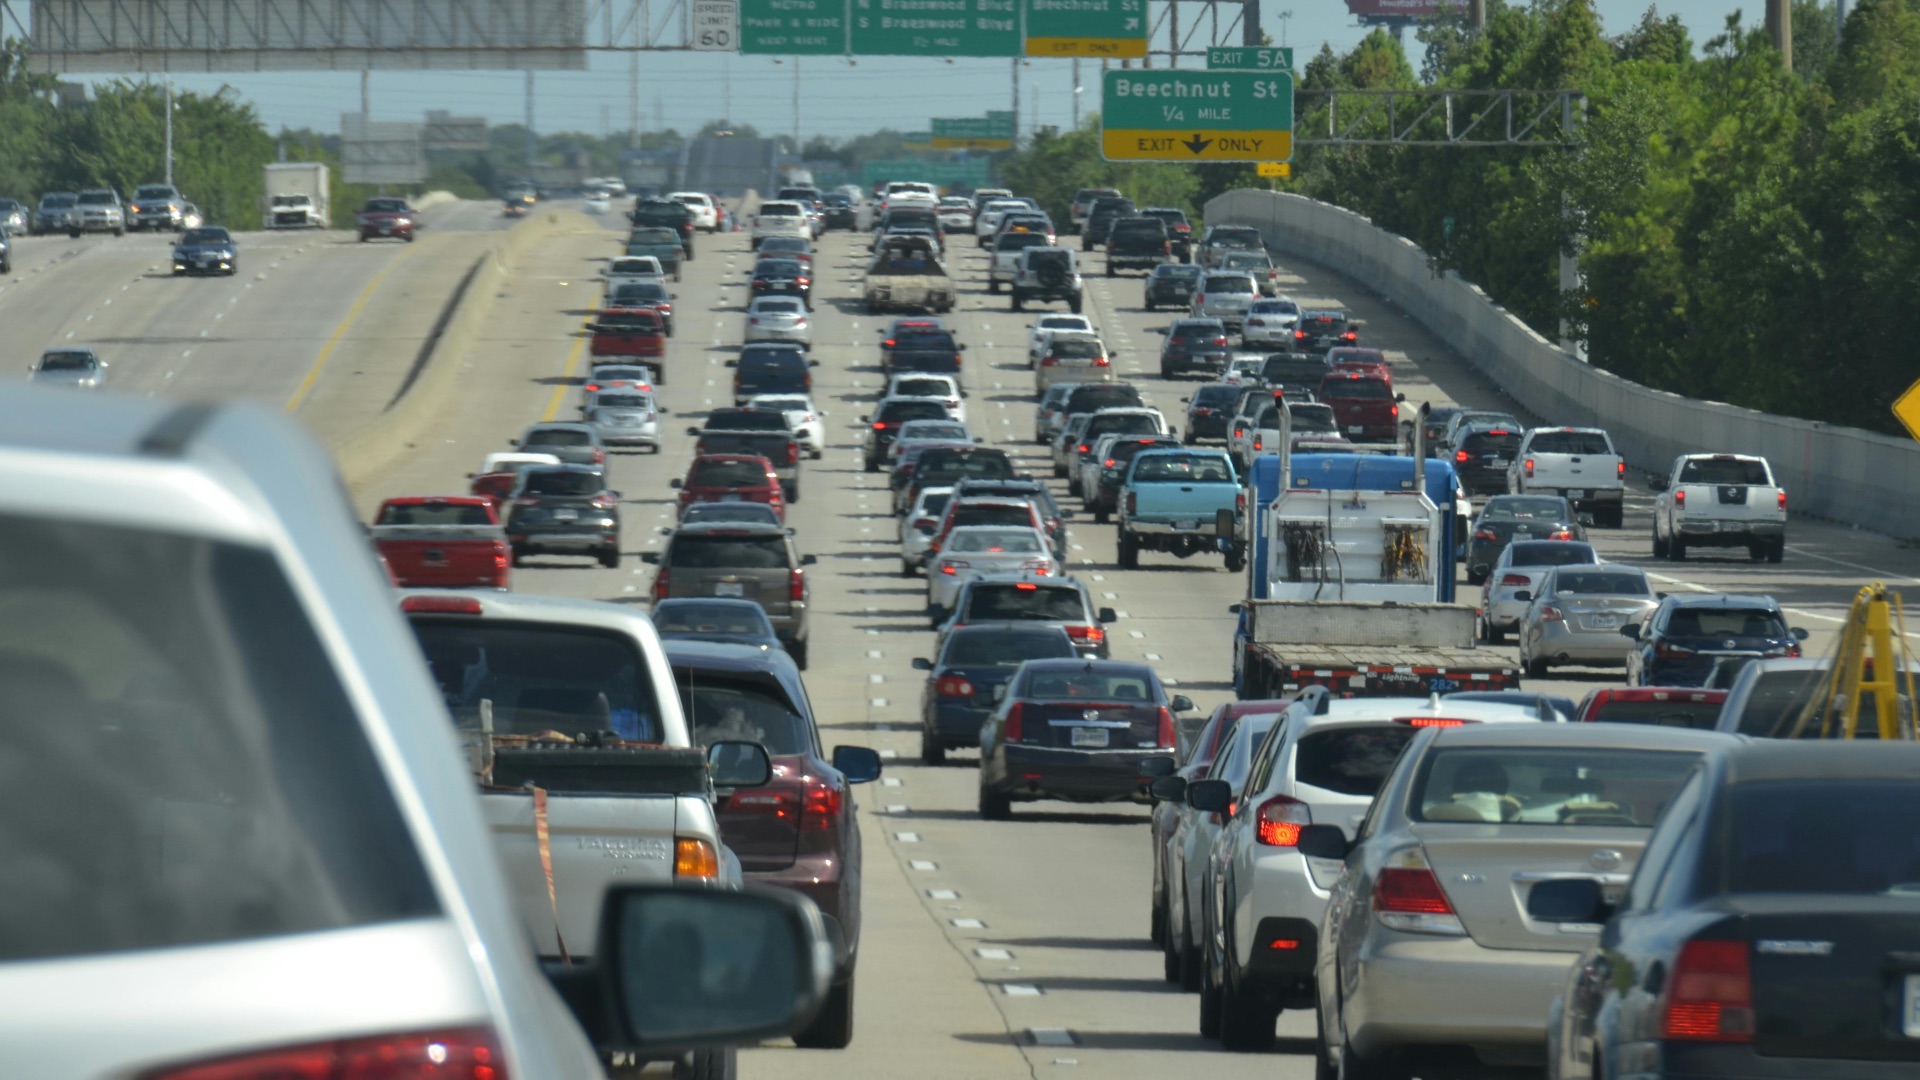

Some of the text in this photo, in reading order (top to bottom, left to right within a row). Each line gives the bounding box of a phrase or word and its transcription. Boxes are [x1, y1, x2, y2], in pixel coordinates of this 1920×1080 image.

[694, 4, 734, 13] SPEED
[769, 0, 816, 10] METRO
[882, 0, 966, 11] Braeswood
[977, 0, 1014, 11] Blvd
[1033, 0, 1140, 11] Beechnut St
[699, 16, 729, 25] LIMIT
[746, 17, 840, 28] PARK & RIDE
[858, 16, 1015, 31] S Braeswood Blvd
[700, 30, 730, 46] 60
[757, 36, 828, 46] NEXT RIGHT
[934, 37, 960, 47] MILE
[1052, 42, 1119, 53] EXIT ONLY
[1212, 50, 1288, 67] EXIT 5A
[1116, 79, 1278, 98] Beechnut St
[1198, 108, 1231, 120] MILE
[1138, 138, 1263, 151] EXIT ONLY
[1382, 672, 1421, 683] Lightning
[1430, 677, 1453, 690] 282
